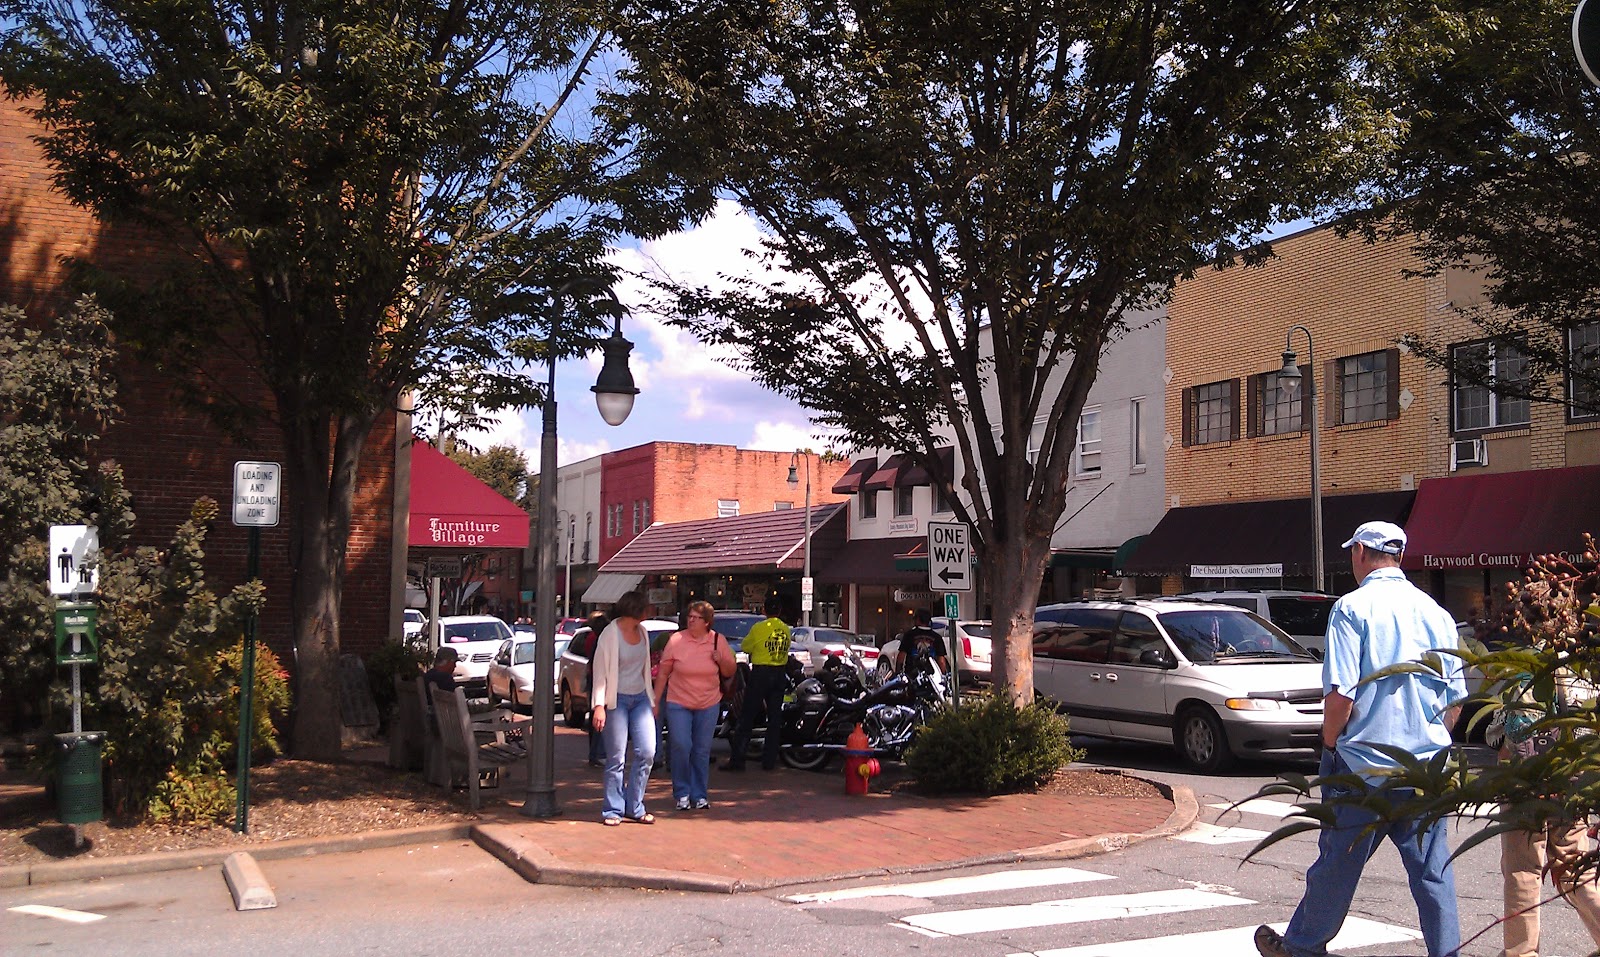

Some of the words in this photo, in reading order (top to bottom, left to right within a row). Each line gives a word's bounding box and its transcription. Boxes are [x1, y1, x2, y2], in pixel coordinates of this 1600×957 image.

[242, 471, 273, 480] LOADING
[250, 483, 265, 492] AND
[236, 496, 277, 505] UNLOADING
[247, 508, 265, 518] ZONE
[429, 517, 500, 532] Furniture
[432, 529, 485, 546] Village
[934, 527, 964, 544] ONE
[933, 546, 965, 563] WAY
[1423, 554, 1475, 569] Haywood
[1478, 553, 1521, 567] County
[1192, 566, 1202, 575] The
[1203, 566, 1227, 575] Cheddar
[1228, 566, 1240, 575] Box
[1240, 566, 1265, 576] Country
[1265, 566, 1281, 574] Store
